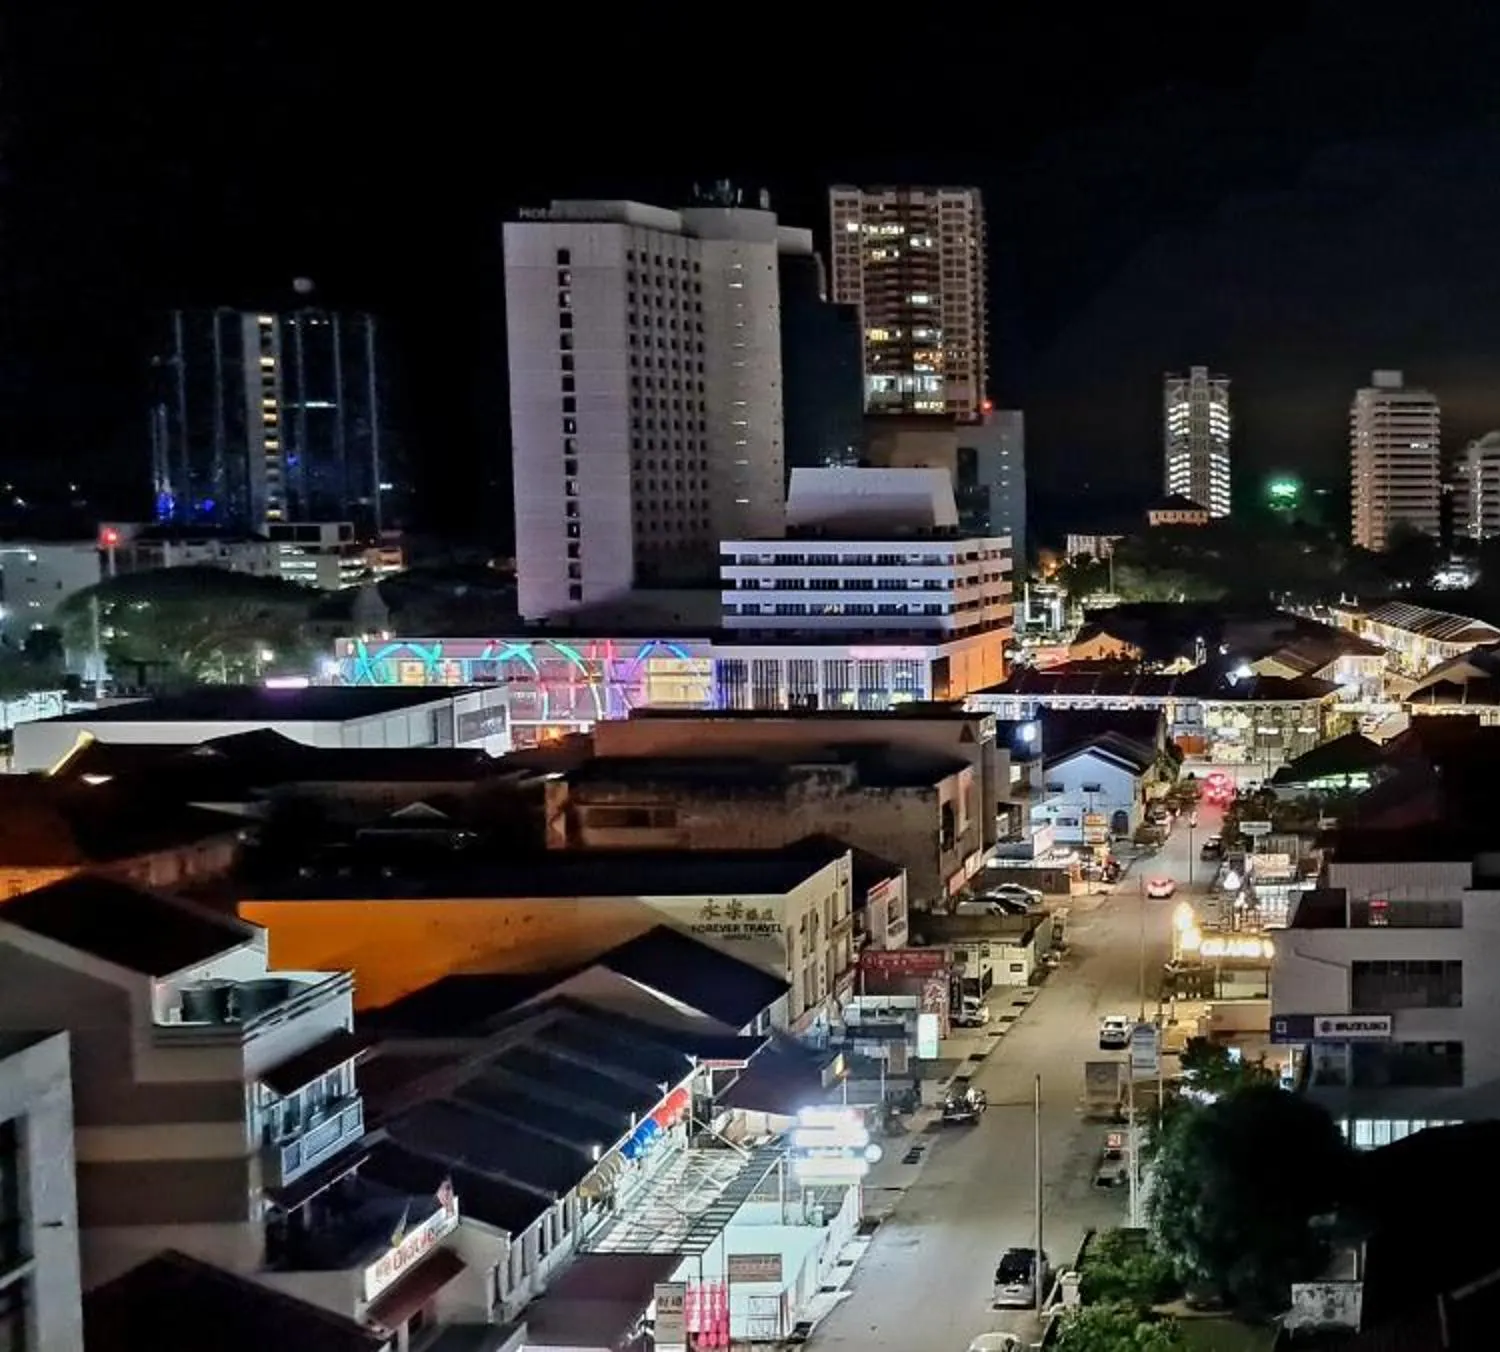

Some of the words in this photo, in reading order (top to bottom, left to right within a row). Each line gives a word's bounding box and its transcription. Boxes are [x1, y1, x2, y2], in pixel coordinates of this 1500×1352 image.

[690, 922, 740, 935] FOREVER
[744, 922, 783, 934] TRAVEL
[1335, 1021, 1388, 1032] SUZUKI
